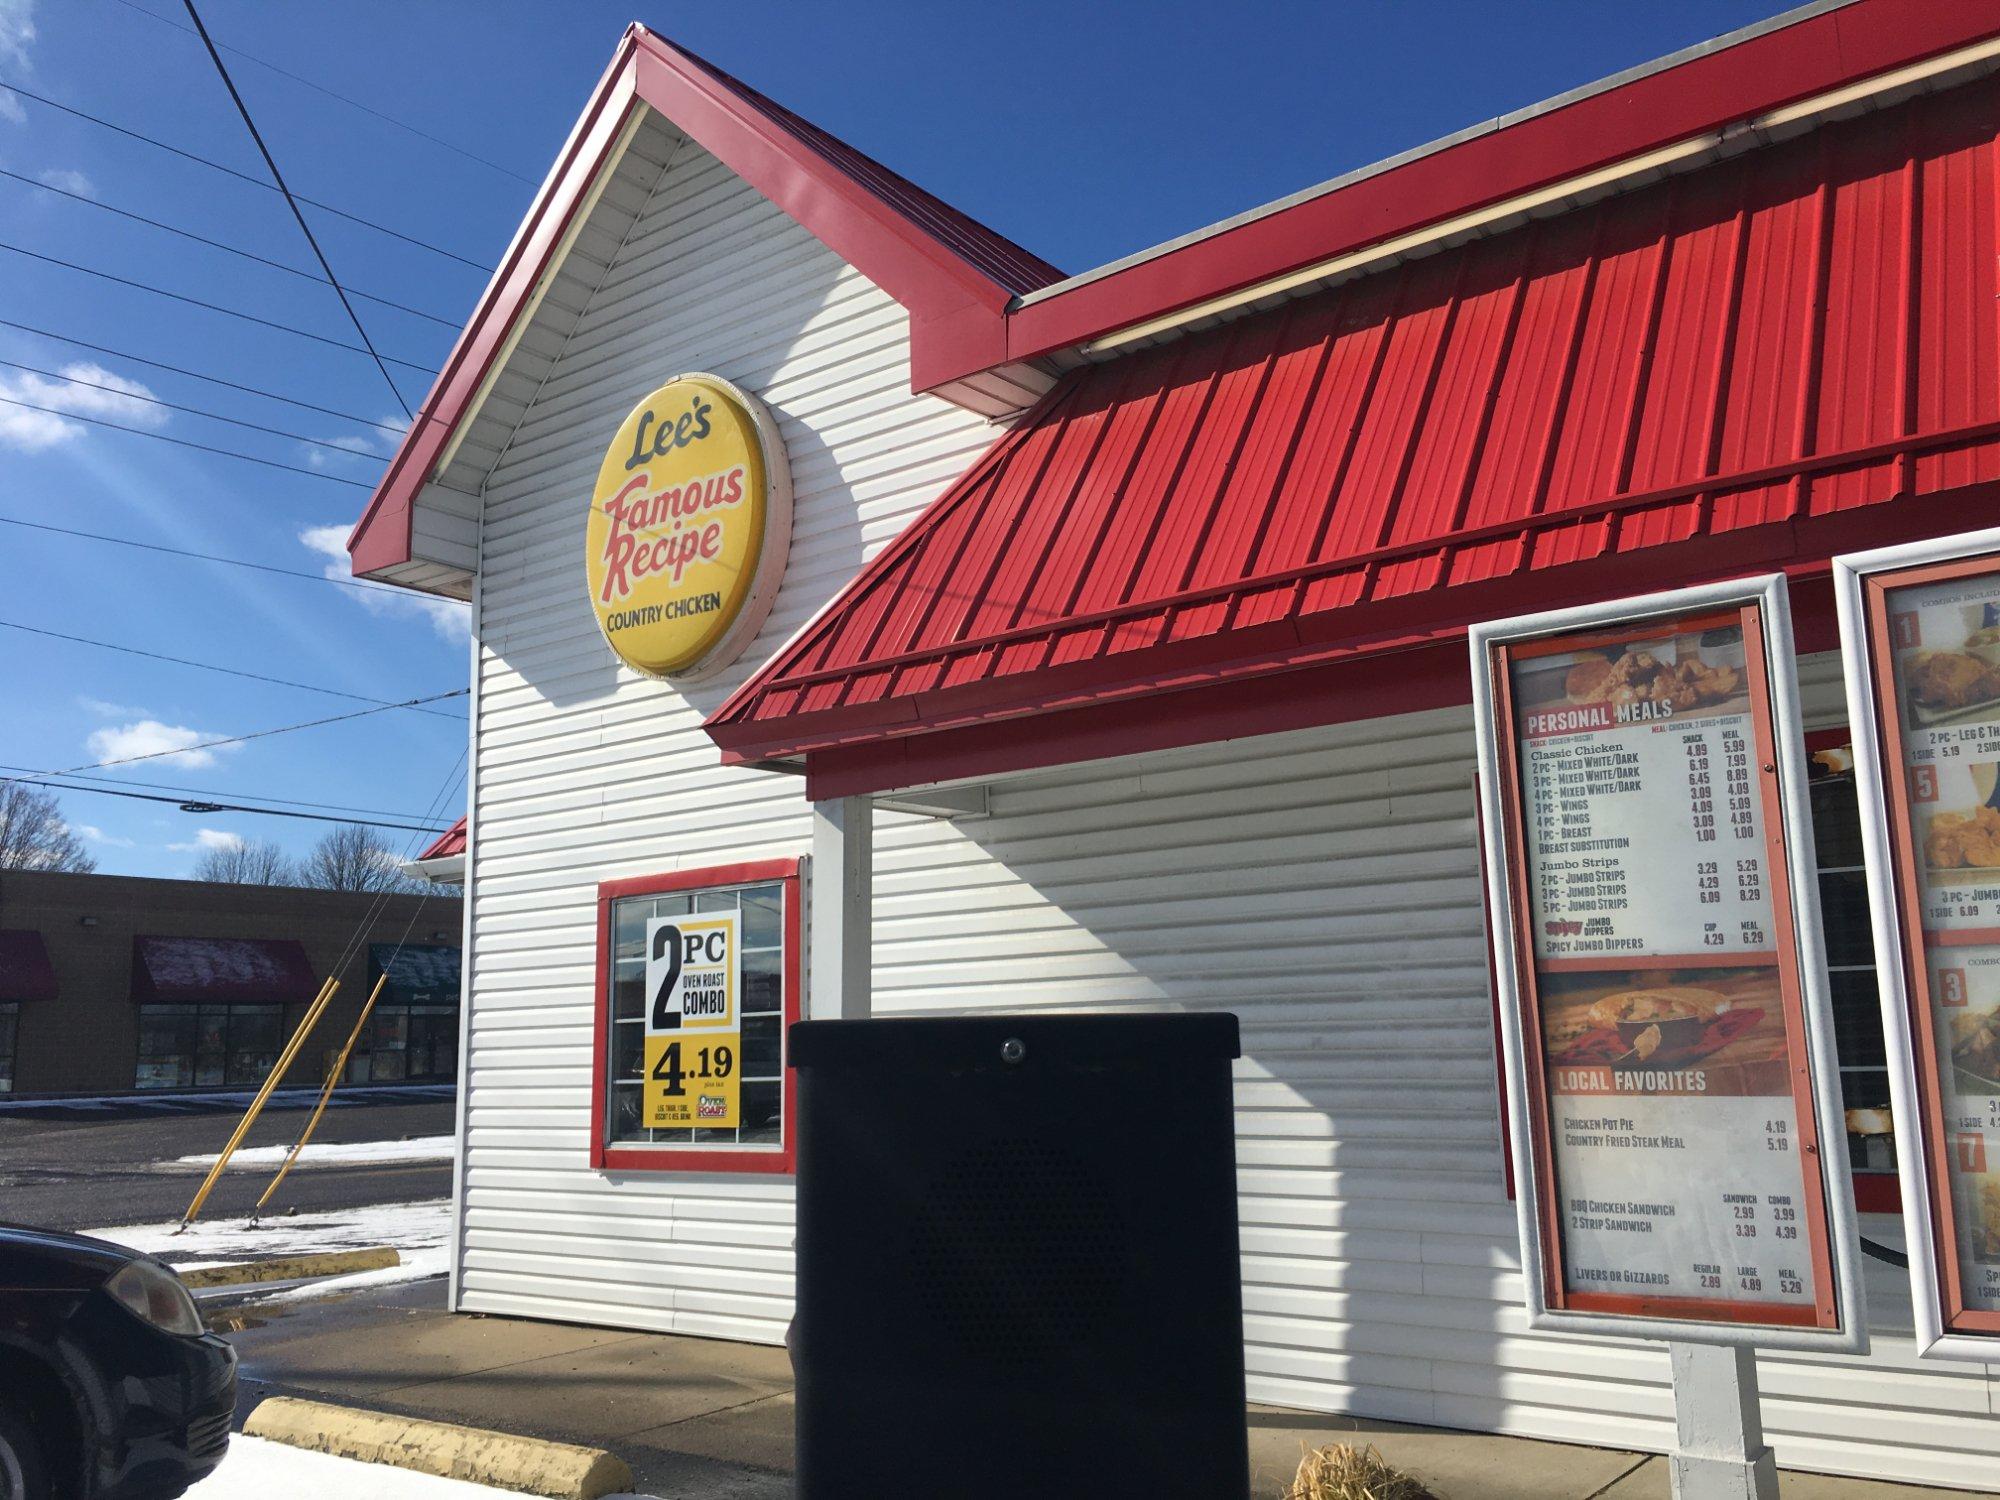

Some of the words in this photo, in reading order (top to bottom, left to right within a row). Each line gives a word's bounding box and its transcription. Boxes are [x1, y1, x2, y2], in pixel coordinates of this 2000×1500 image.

[625, 396, 711, 470] Lee's
[604, 468, 743, 560] Famous
[602, 520, 720, 602] Recipe
[607, 604, 663, 633] COUNTRY
[665, 591, 721, 620] CHICKEN
[1901, 617, 1911, 642] 1
[1528, 707, 1610, 734] PERSONAL
[1615, 699, 1672, 723] MEALS
[1682, 734, 1703, 744] SNACK
[1722, 730, 1740, 740] MEAL
[1929, 732, 1936, 744] 2
[1938, 732, 1951, 743] PC
[1959, 729, 1976, 741] LEG
[1531, 749, 1572, 761] Classic
[1574, 744, 1624, 756] Chicken
[1686, 744, 1708, 757] 4.89
[1723, 740, 1745, 753] 5.99
[1912, 750, 1916, 761] 1
[1917, 749, 1936, 760] SIDE
[1942, 746, 1960, 757] 5.19
[1977, 743, 1983, 754] 2
[1532, 763, 1539, 774] 2
[1540, 762, 1550, 773] PC
[1557, 759, 1583, 771] MIXED
[1584, 752, 1639, 769] WHITE/DARK
[1689, 758, 1709, 771] 6.19
[1726, 753, 1747, 767] 7.99
[1533, 776, 1540, 788] 3
[1541, 776, 1552, 787] PC
[1558, 773, 1584, 785] MIXED
[1585, 766, 1640, 781] WHITE/DARK
[1688, 772, 1710, 785] 6.45
[1726, 768, 1748, 782] 8.89
[1917, 769, 1932, 798] 5
[1535, 790, 1541, 801] 4
[1542, 789, 1553, 800] PC
[1560, 786, 1586, 798] MIXED
[1586, 780, 1642, 796] WHITE/DARK
[1690, 786, 1711, 799] 3.09
[1727, 782, 1749, 795] 4.09
[1536, 803, 1541, 814] 3
[1543, 803, 1554, 814] PC
[1560, 799, 1589, 812] WINGS
[1691, 800, 1713, 813] 4.09
[1729, 797, 1751, 810] 5.09
[1536, 816, 1542, 828] 4
[1544, 816, 1555, 827] PC
[1562, 813, 1590, 825] WINGS
[1693, 814, 1714, 828] 3.09
[1731, 811, 1752, 825] 4.89
[1538, 830, 1543, 842] 1
[1544, 830, 1554, 841] PC
[1561, 827, 1592, 839] BREAST
[1696, 829, 1716, 842] 1.00
[1734, 826, 1754, 839] 1.00
[1539, 842, 1571, 855] BREAST
[1570, 837, 1630, 852] SUBSTITUTION
[1540, 861, 1579, 871] Jumbo
[1582, 858, 1619, 870] Strips
[1697, 862, 1718, 874] 3.29
[1737, 859, 1758, 872] 5.29
[1541, 875, 1547, 886] 2
[1548, 875, 1559, 885] PC
[1565, 872, 1594, 884] JUMBO
[1596, 870, 1626, 882] STRIPS
[1699, 876, 1719, 889] 4.29
[1738, 874, 1759, 886] 6.29
[1542, 889, 1548, 900] 3
[1549, 889, 1560, 900] PC
[1567, 887, 1596, 898] JUMBO
[1597, 884, 1627, 897] STRIPS
[1700, 891, 1721, 904] 6.09
[1740, 889, 1760, 901] 8.29
[1941, 891, 1948, 903] 3
[1950, 891, 1963, 903] PC
[1972, 889, 2000, 901] JUMB
[1544, 903, 1549, 913] 5
[1551, 902, 1561, 913] PC
[1568, 900, 1597, 912] JUMBO
[1598, 898, 1628, 909] STRIPS
[1929, 908, 1934, 918] 1
[1935, 908, 1953, 918] SIDE
[1960, 905, 1979, 917] 6.09
[1585, 917, 1611, 927] JUMBO
[1704, 922, 1717, 932] CUP
[1741, 921, 1759, 930] MEAL
[1584, 926, 1614, 936] DIPPERS
[1704, 933, 1724, 945] 4.29
[1743, 931, 1764, 944] 6.29
[1546, 941, 1571, 953] SPICY
[1573, 940, 1604, 952] JUMBO
[1605, 938, 1644, 950] DIPPERS
[652, 924, 682, 1029] 2
[683, 931, 726, 964] PC
[683, 974, 701, 988] OVEN
[703, 972, 725, 987] ROAST
[1945, 972, 1961, 1002] 3
[683, 989, 725, 1015] COMBO
[652, 1042, 733, 1096] 4.19
[1558, 1071, 1610, 1090] LOCAL
[1615, 1071, 1706, 1091] FAVORITES
[1989, 1100, 1997, 1113] 3
[1564, 1118, 1601, 1130] CHICKEN
[1602, 1118, 1618, 1131] POT
[1619, 1119, 1634, 1131] PIE
[1765, 1120, 1787, 1133] 4.19
[1964, 1117, 1983, 1128] SIDE
[1565, 1134, 1604, 1147] COUNTRY
[1605, 1135, 1631, 1148] FRIED
[1632, 1136, 1660, 1148] STEAK
[1661, 1136, 1686, 1149] MEAL
[1767, 1138, 1788, 1151] 5.19
[1962, 1137, 1976, 1168] 7
[1571, 1199, 1588, 1213] BBQ
[1589, 1200, 1626, 1214] CHICKEN
[1627, 1202, 1675, 1216] SANDWICH
[1722, 1194, 1758, 1204] SANDWICH
[1768, 1195, 1792, 1205] COMBO
[1734, 1206, 1755, 1219] 2.99
[1774, 1208, 1795, 1221] 3.99
[1572, 1216, 1578, 1229] 2
[1579, 1217, 1603, 1230] STRIP
[1605, 1218, 1652, 1232] SANDWICH
[1735, 1224, 1756, 1237] 3.39
[1775, 1226, 1797, 1240] 4.39
[1575, 1268, 1608, 1281] LIVERS
[1609, 1270, 1622, 1282] OR
[1623, 1270, 1670, 1285] GIZZARDS
[1693, 1264, 1721, 1274] REGULAR
[1737, 1266, 1758, 1277] LARGE
[1778, 1269, 1797, 1279] MEAL
[1701, 1275, 1721, 1289] 2.89
[1741, 1278, 1762, 1291] 4.89
[1780, 1281, 1802, 1294] 5.29
